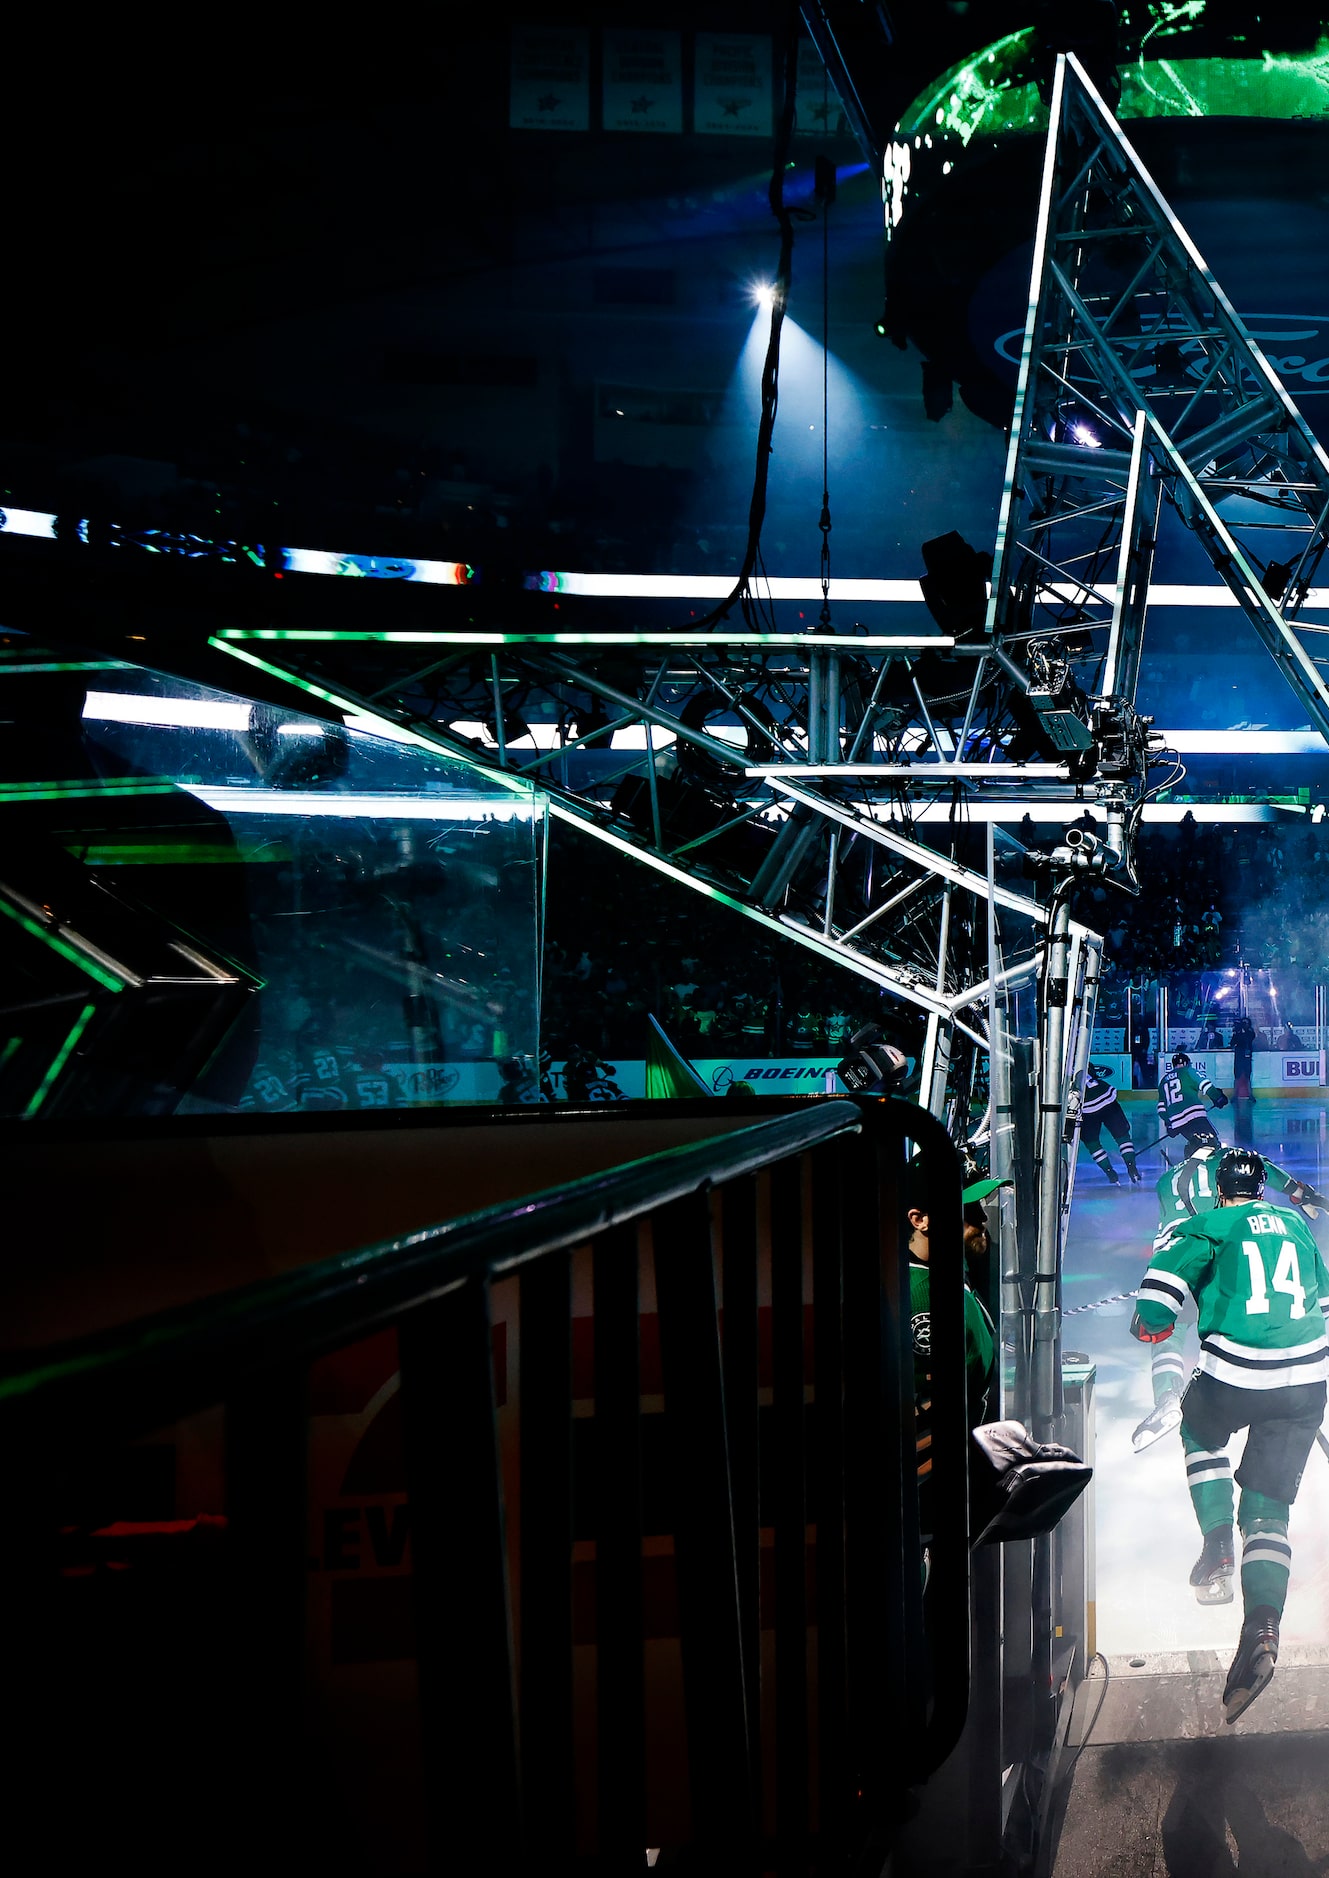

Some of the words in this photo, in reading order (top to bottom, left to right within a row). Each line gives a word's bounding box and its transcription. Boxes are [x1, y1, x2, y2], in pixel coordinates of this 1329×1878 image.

[1163, 1078, 1184, 1107] 12
[1247, 1213, 1288, 1235] BENN
[1242, 1240, 1307, 1320] 14
